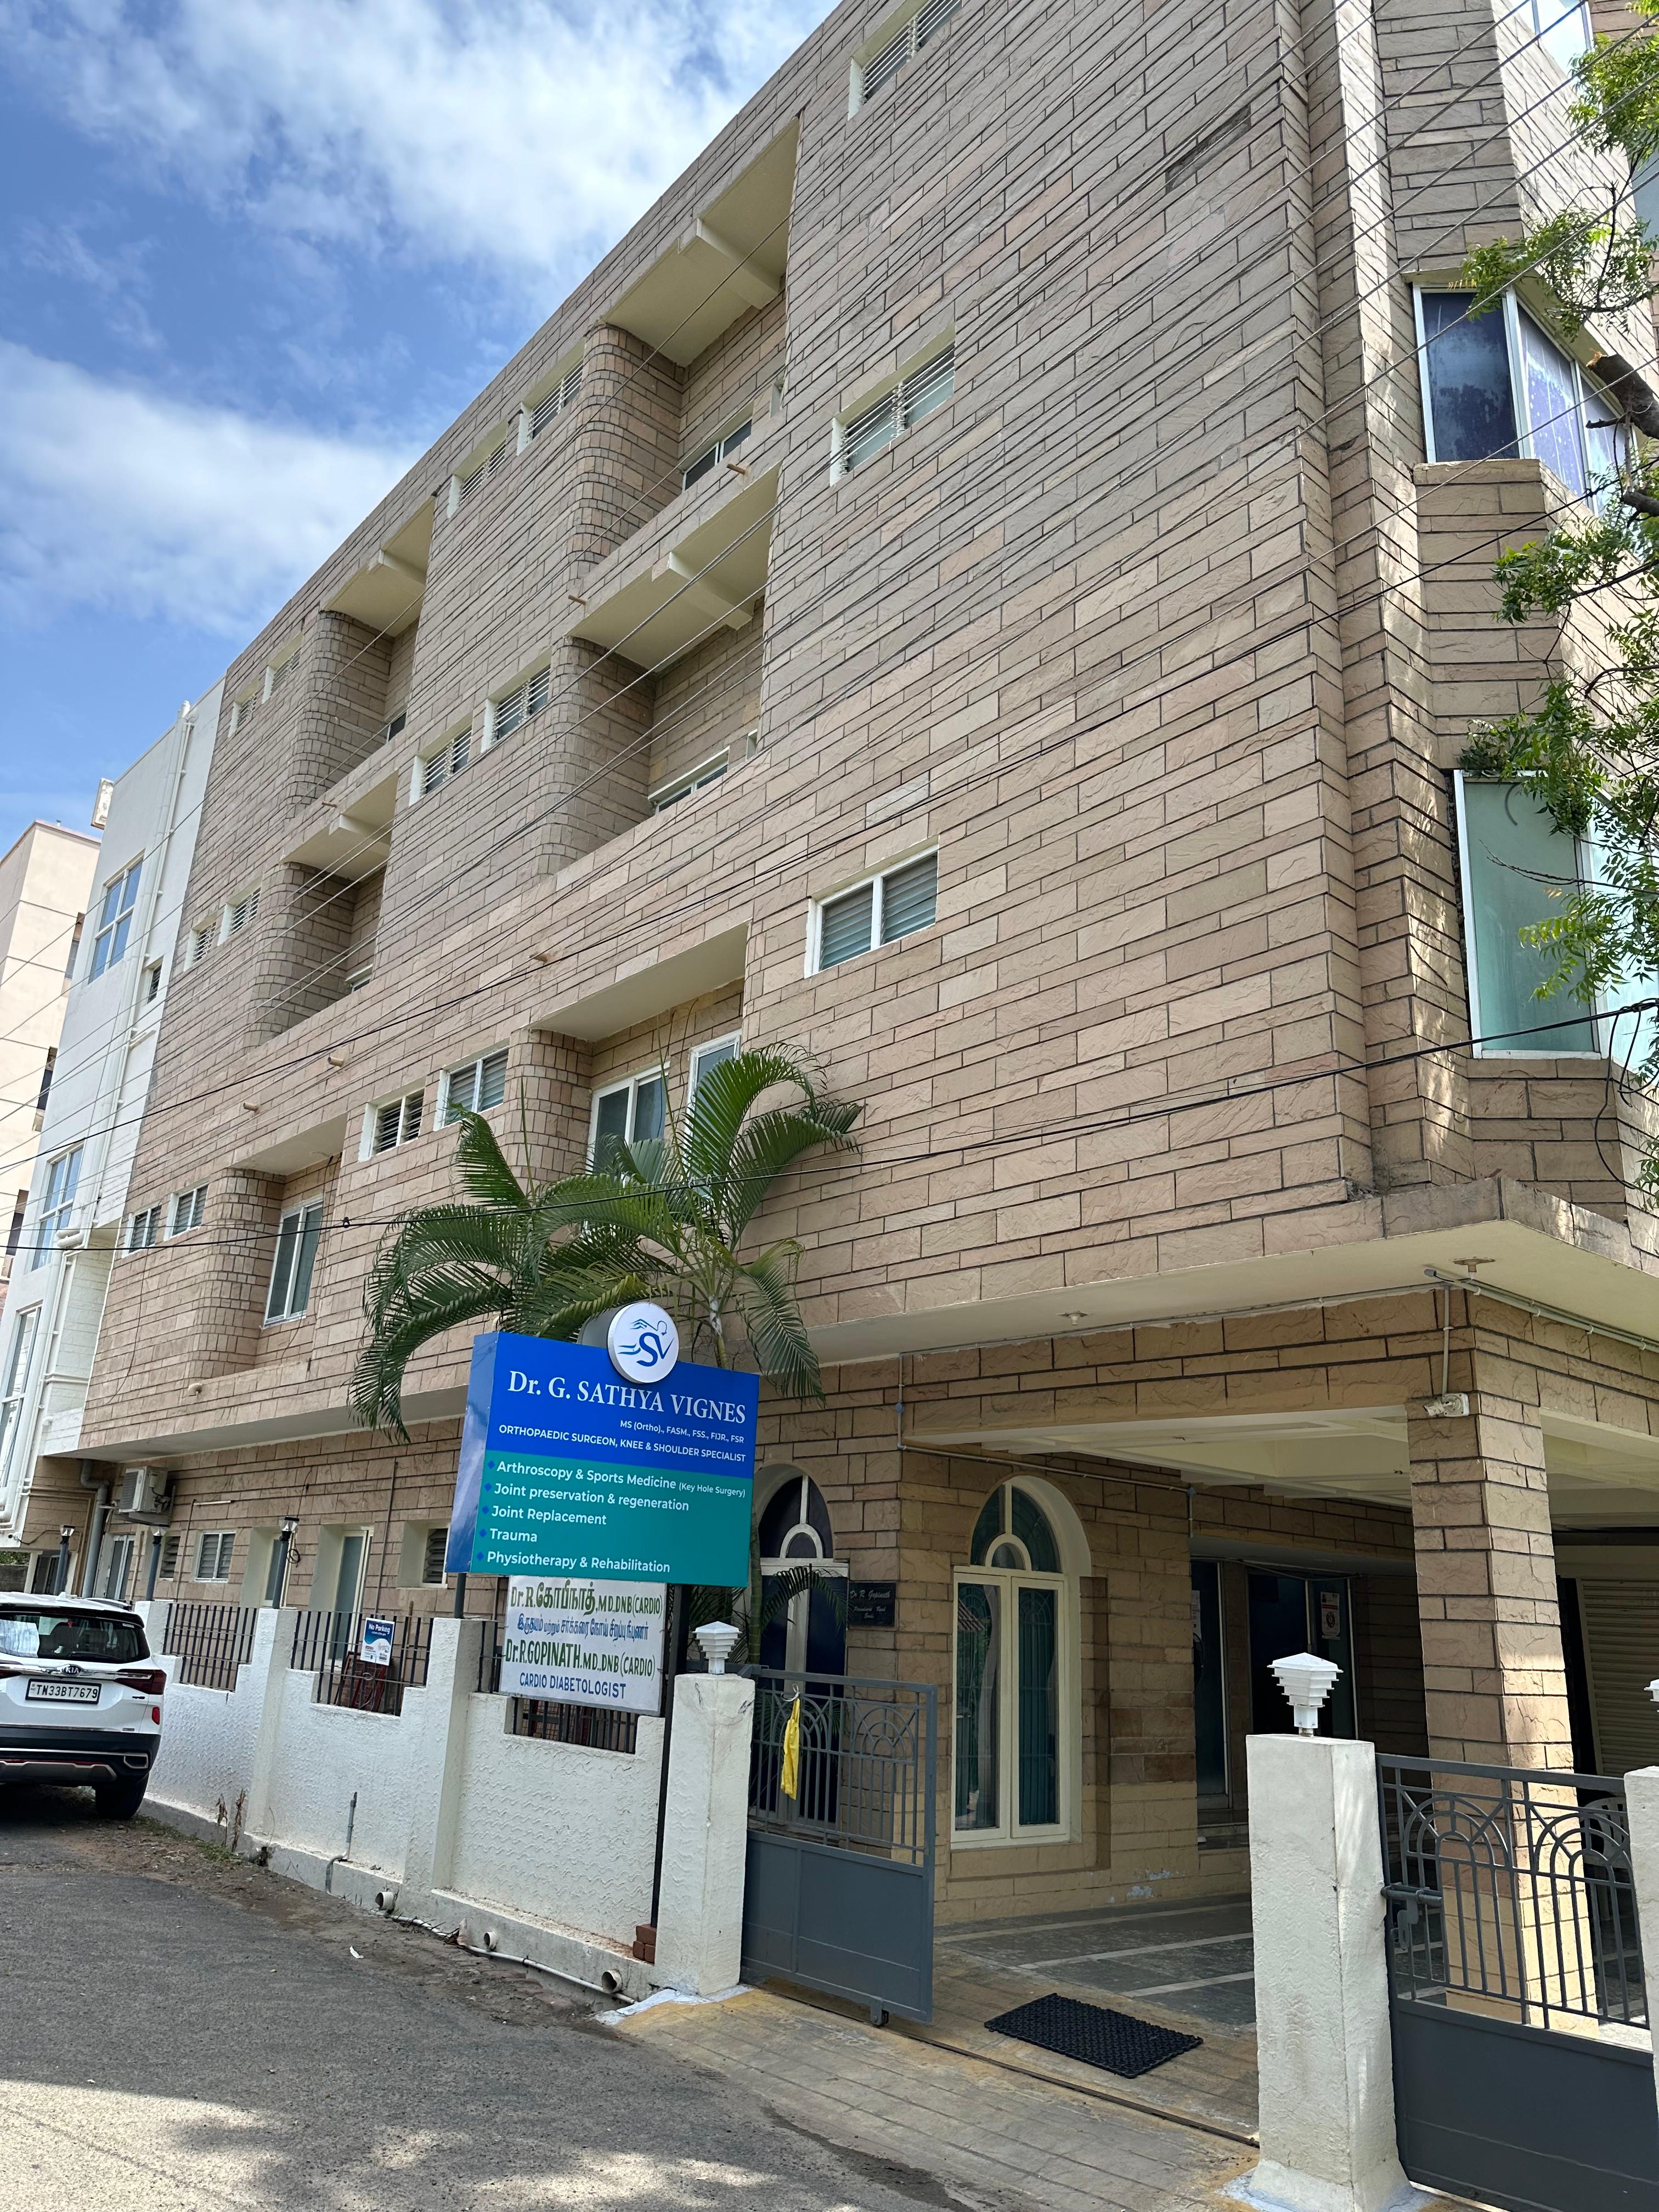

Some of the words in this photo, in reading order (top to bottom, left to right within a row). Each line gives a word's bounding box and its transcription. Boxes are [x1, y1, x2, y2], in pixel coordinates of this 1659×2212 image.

[507, 1370, 541, 1395] Dr.
[549, 1377, 571, 1399] G.
[577, 1381, 664, 1412] SATHYA
[670, 1394, 746, 1424] VIGNES
[620, 1420, 632, 1429] MS
[666, 1426, 690, 1437] FASM.,
[692, 1430, 709, 1440] FSS.,
[731, 1435, 744, 1443] FSR
[499, 1425, 569, 1440] ORTHOPAEDIC
[571, 1433, 618, 1448] SURGEON,
[620, 1439, 644, 1449] KNEE
[645, 1442, 652, 1451] &
[653, 1443, 699, 1456] SHOULDER
[701, 1449, 746, 1462] SPECIALIST
[497, 1461, 573, 1481] Arthroscopy
[575, 1469, 584, 1480] &
[586, 1470, 624, 1483] Sports
[627, 1474, 676, 1489] Medicine
[679, 1482, 695, 1492] (Key
[697, 1485, 713, 1493] Hole
[715, 1486, 746, 1498] Surgery)
[494, 1483, 526, 1496] Joint
[529, 1487, 604, 1503] preservation
[607, 1493, 616, 1504] &
[618, 1496, 689, 1511] regeneration
[492, 1505, 523, 1519] Joint
[527, 1508, 607, 1525] Replacement
[490, 1528, 538, 1542] Trauma
[487, 1551, 577, 1570] Physiotherapy
[579, 1556, 588, 1567] &
[591, 1557, 670, 1573] Rehabilitation
[375, 1624, 391, 1634] Parking
[36, 1684, 98, 1699] TN33BT7679
[520, 1673, 547, 1688] CARDIO
[550, 1675, 626, 1699] DIABETOLOGIST
